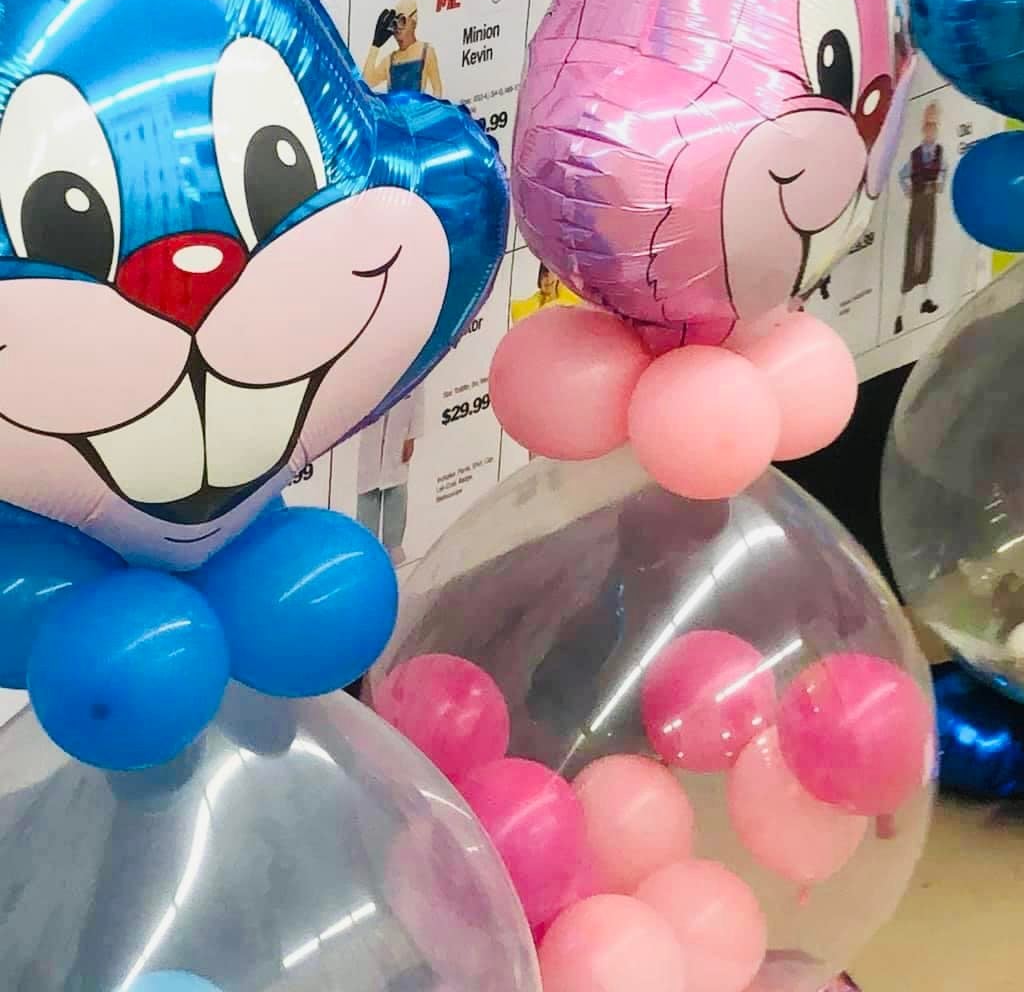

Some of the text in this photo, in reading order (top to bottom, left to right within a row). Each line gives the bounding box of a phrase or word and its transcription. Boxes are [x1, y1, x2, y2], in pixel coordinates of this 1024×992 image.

[462, 24, 500, 44] Minion
[461, 46, 493, 67] Kevin
[441, 394, 491, 426] $29.99
